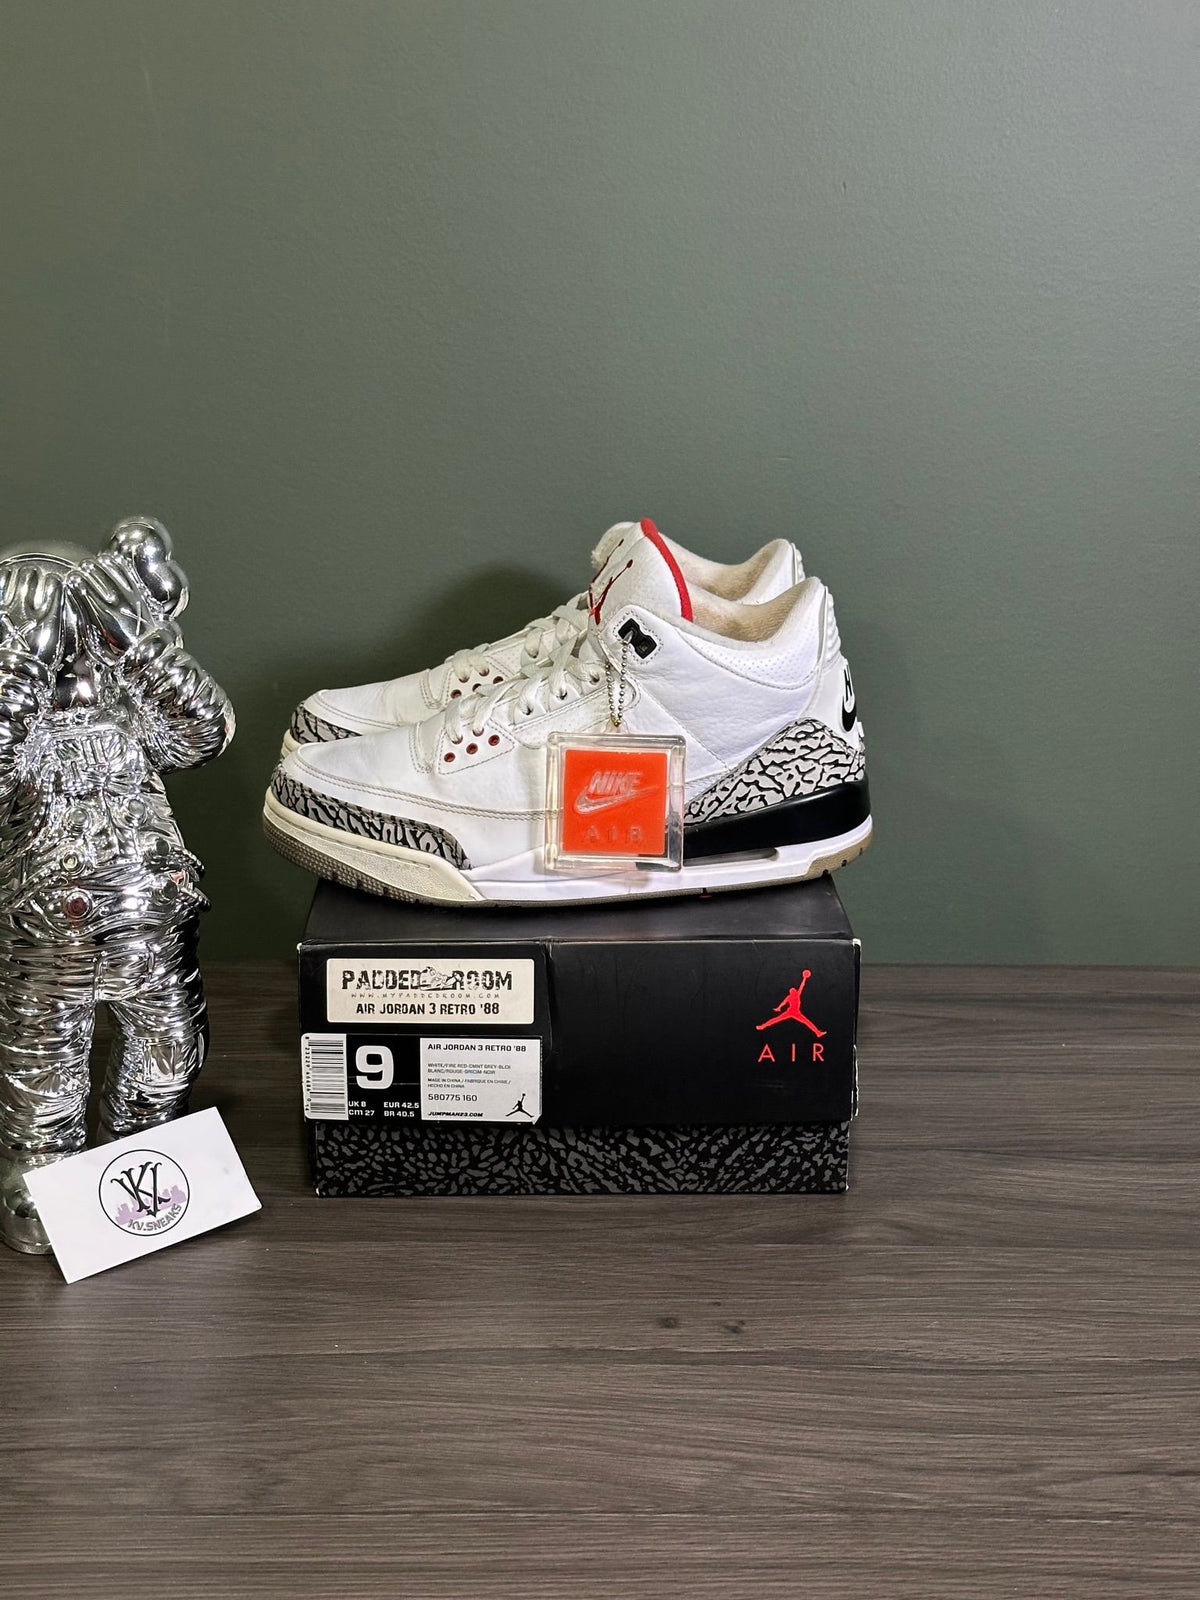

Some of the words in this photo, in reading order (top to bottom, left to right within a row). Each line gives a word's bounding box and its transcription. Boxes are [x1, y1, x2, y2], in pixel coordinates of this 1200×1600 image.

[587, 771, 643, 794] NIKE
[584, 825, 642, 843] AIR
[356, 1003, 375, 1015] AIR
[380, 1003, 425, 1015] JORDAN
[429, 1003, 437, 1015] 3
[440, 1003, 476, 1015] RETRO
[477, 1044, 484, 1052] 3
[757, 1043, 825, 1062] AIR
[355, 1045, 394, 1089] 9
[428, 1093, 461, 1102] 580775
[462, 1094, 478, 1102] 160
